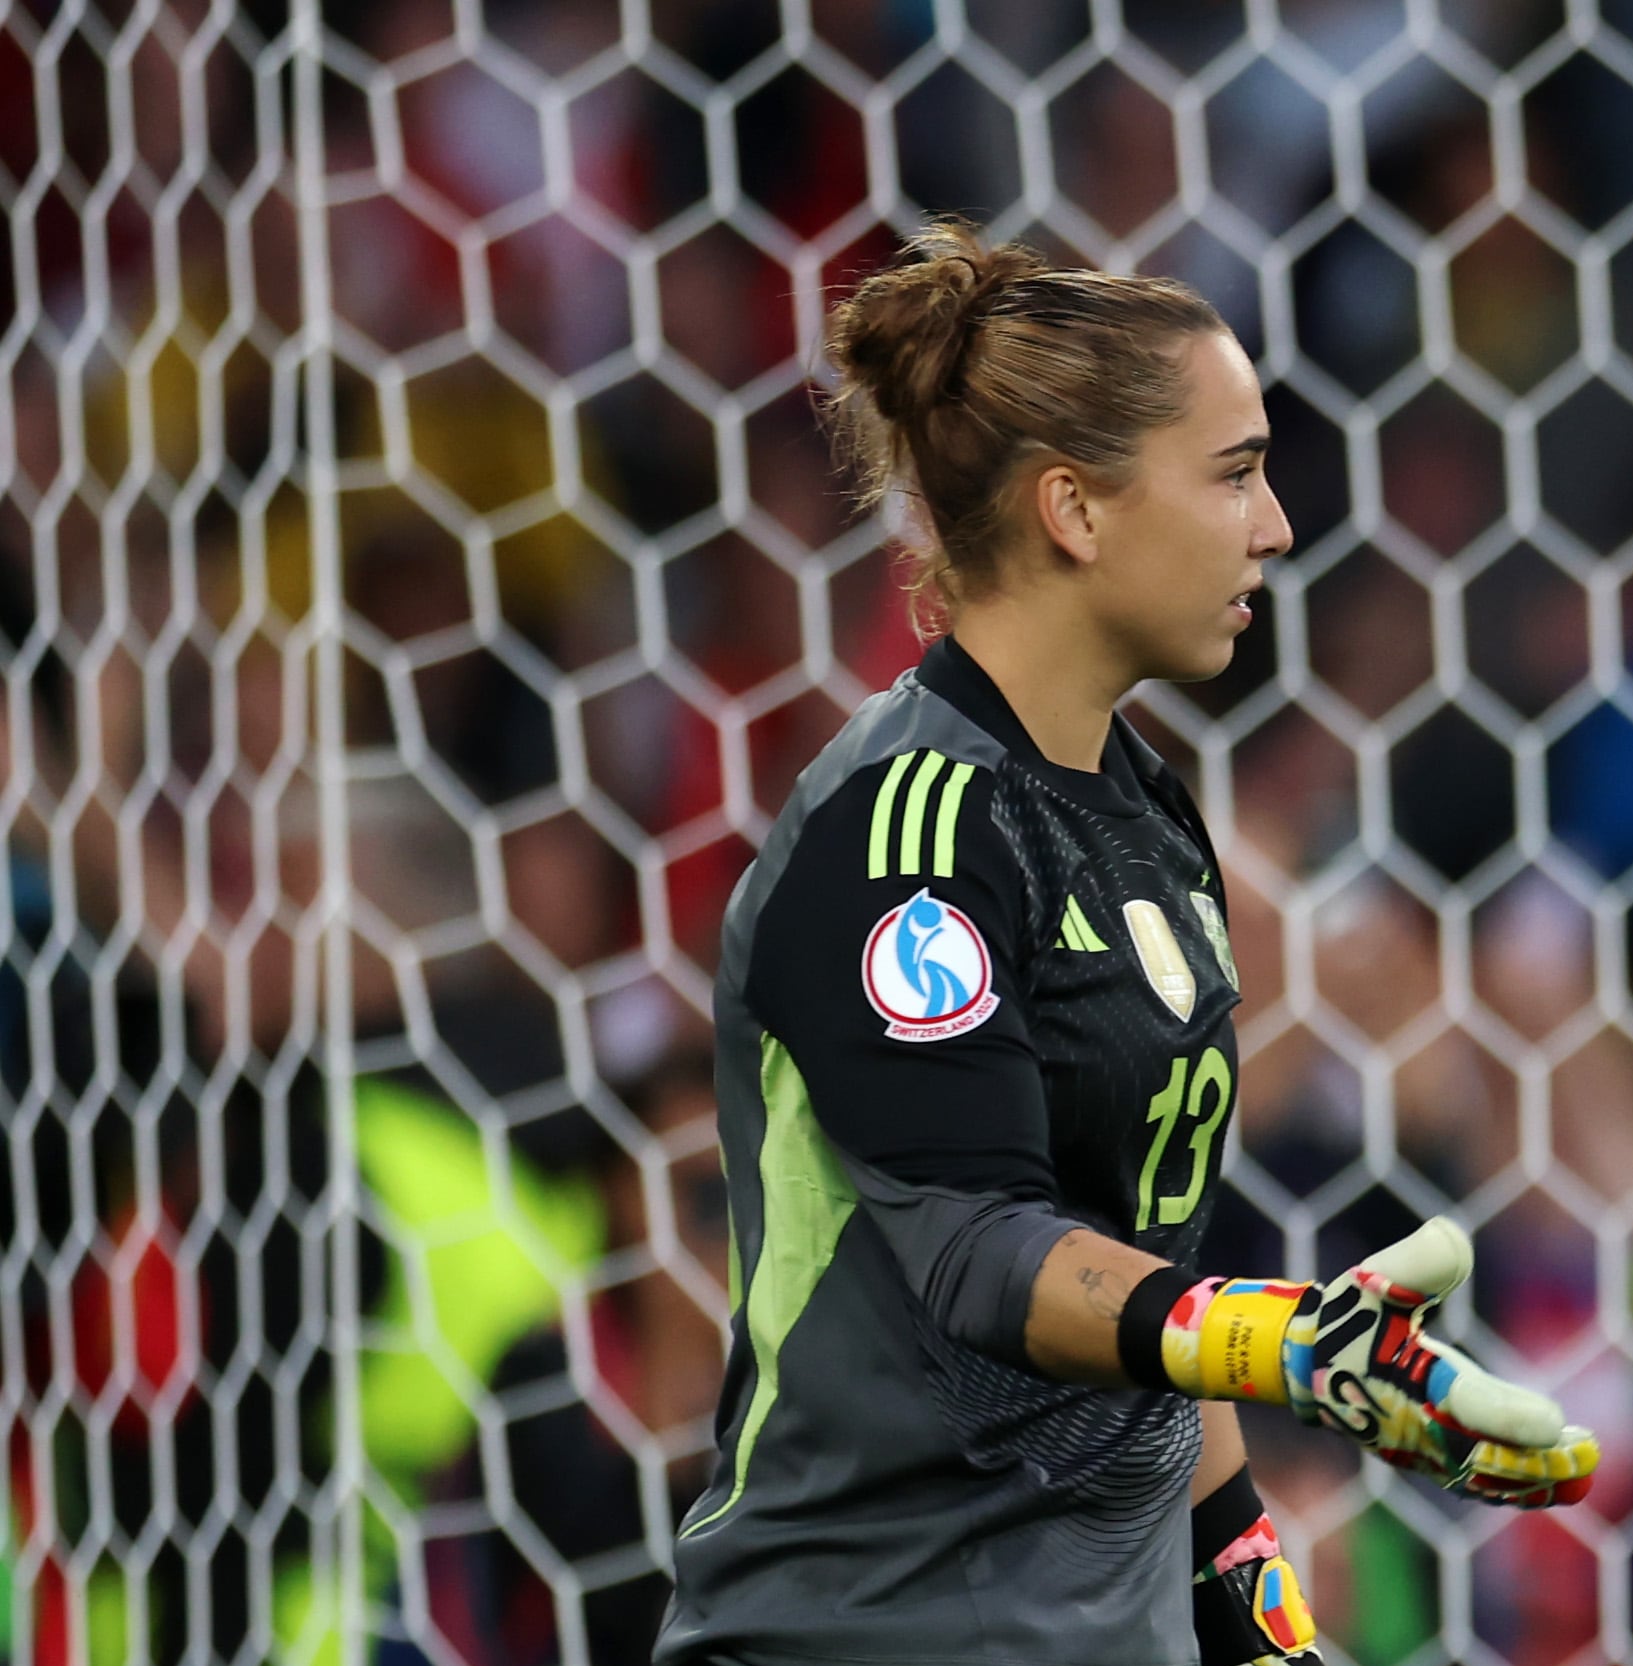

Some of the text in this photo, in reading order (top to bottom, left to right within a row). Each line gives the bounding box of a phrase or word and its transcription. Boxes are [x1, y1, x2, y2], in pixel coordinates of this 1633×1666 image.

[891, 996, 995, 1038] SWITZERLAND 2025
[1136, 1046, 1231, 1231] 13
